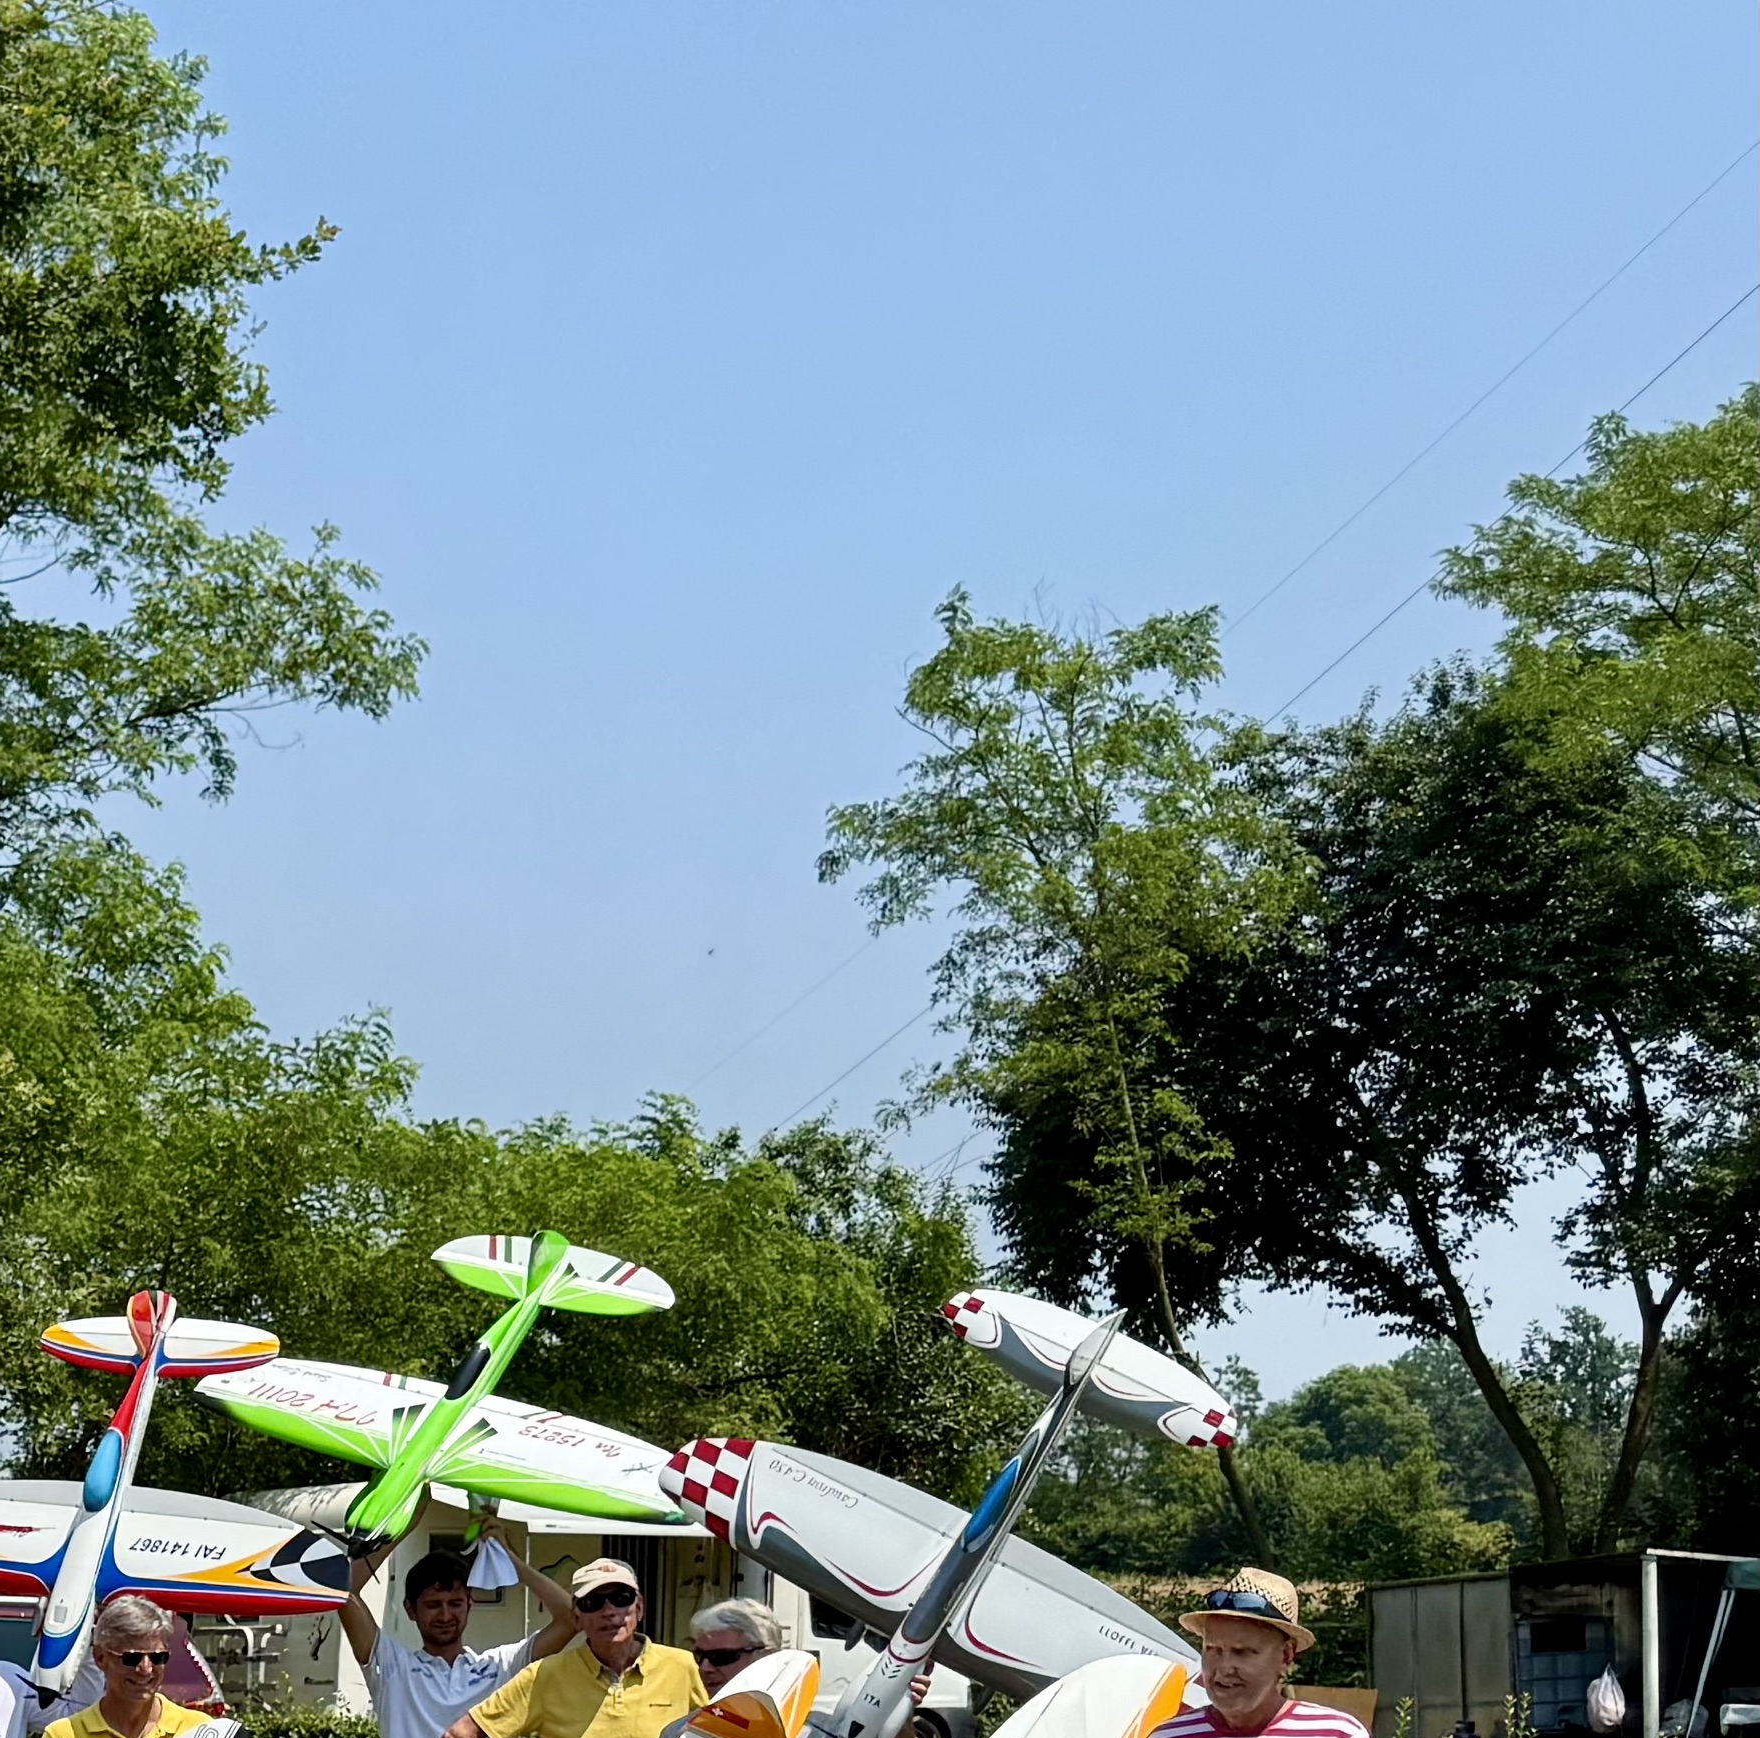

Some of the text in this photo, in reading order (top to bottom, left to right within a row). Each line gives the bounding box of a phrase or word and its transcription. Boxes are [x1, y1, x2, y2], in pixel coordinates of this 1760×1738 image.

[247, 1382, 315, 1408] 20111
[129, 1536, 227, 1561] FAI 141867
